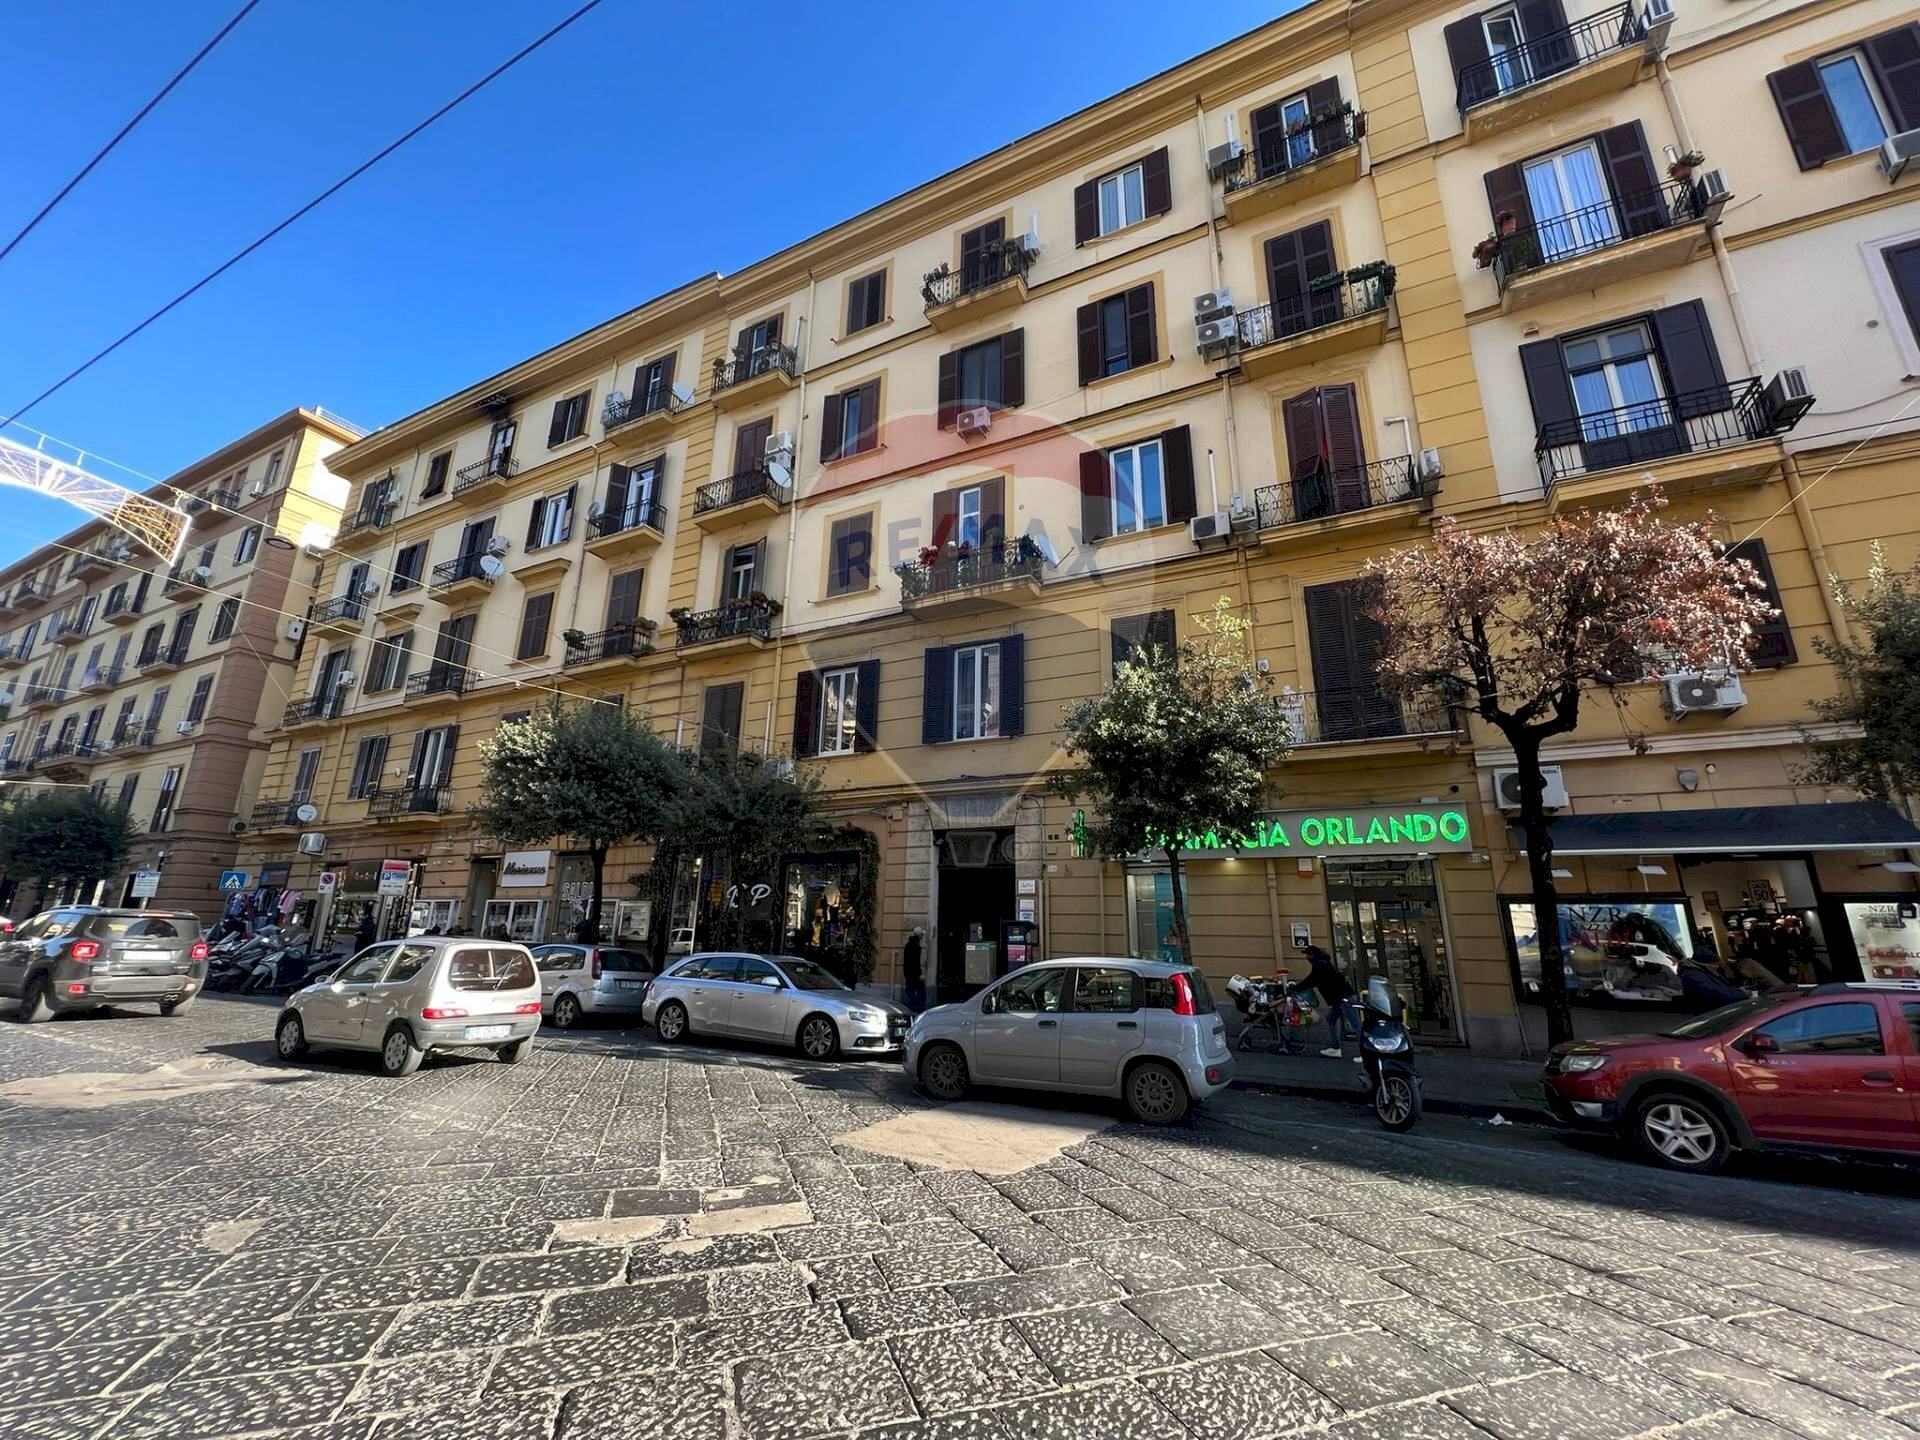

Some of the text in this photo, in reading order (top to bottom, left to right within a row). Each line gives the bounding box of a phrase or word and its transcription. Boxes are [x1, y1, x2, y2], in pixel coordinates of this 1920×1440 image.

[1300, 811, 1467, 847] ORLANDO
[1567, 906, 1623, 922] NZR
[1868, 905, 1896, 913] NZR
